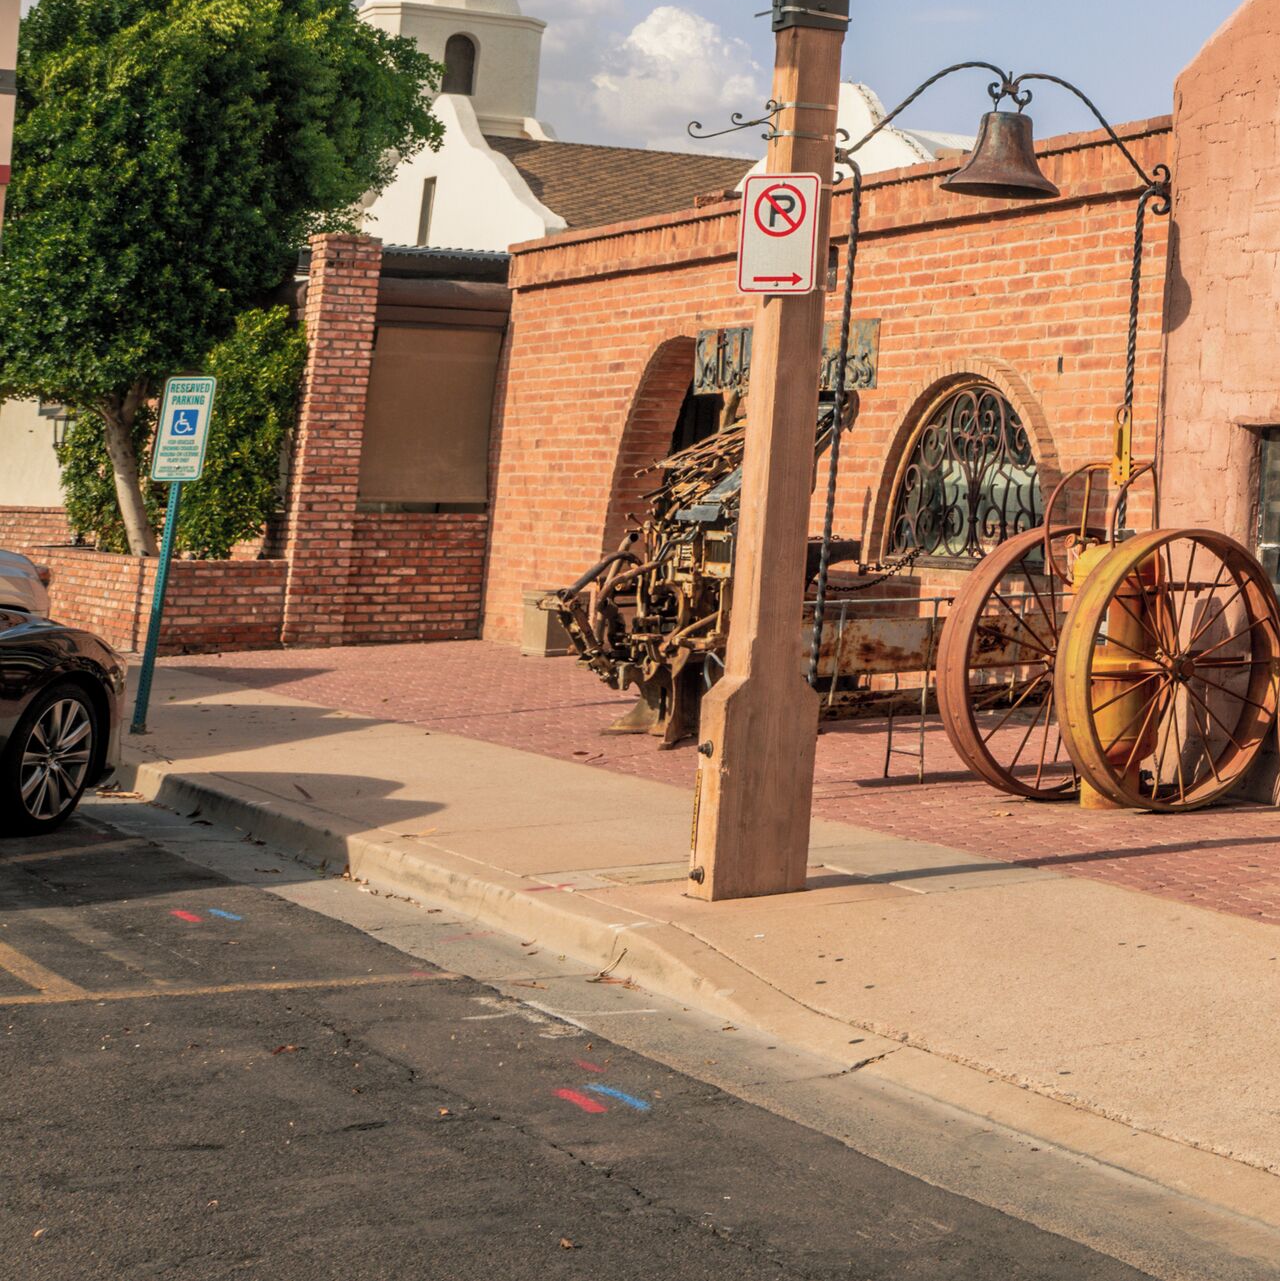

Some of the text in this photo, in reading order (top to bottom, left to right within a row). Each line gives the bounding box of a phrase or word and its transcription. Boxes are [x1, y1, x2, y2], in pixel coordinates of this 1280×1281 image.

[769, 195, 795, 227] P
[170, 383, 211, 393] RESERVED
[171, 395, 206, 405] PARKING
